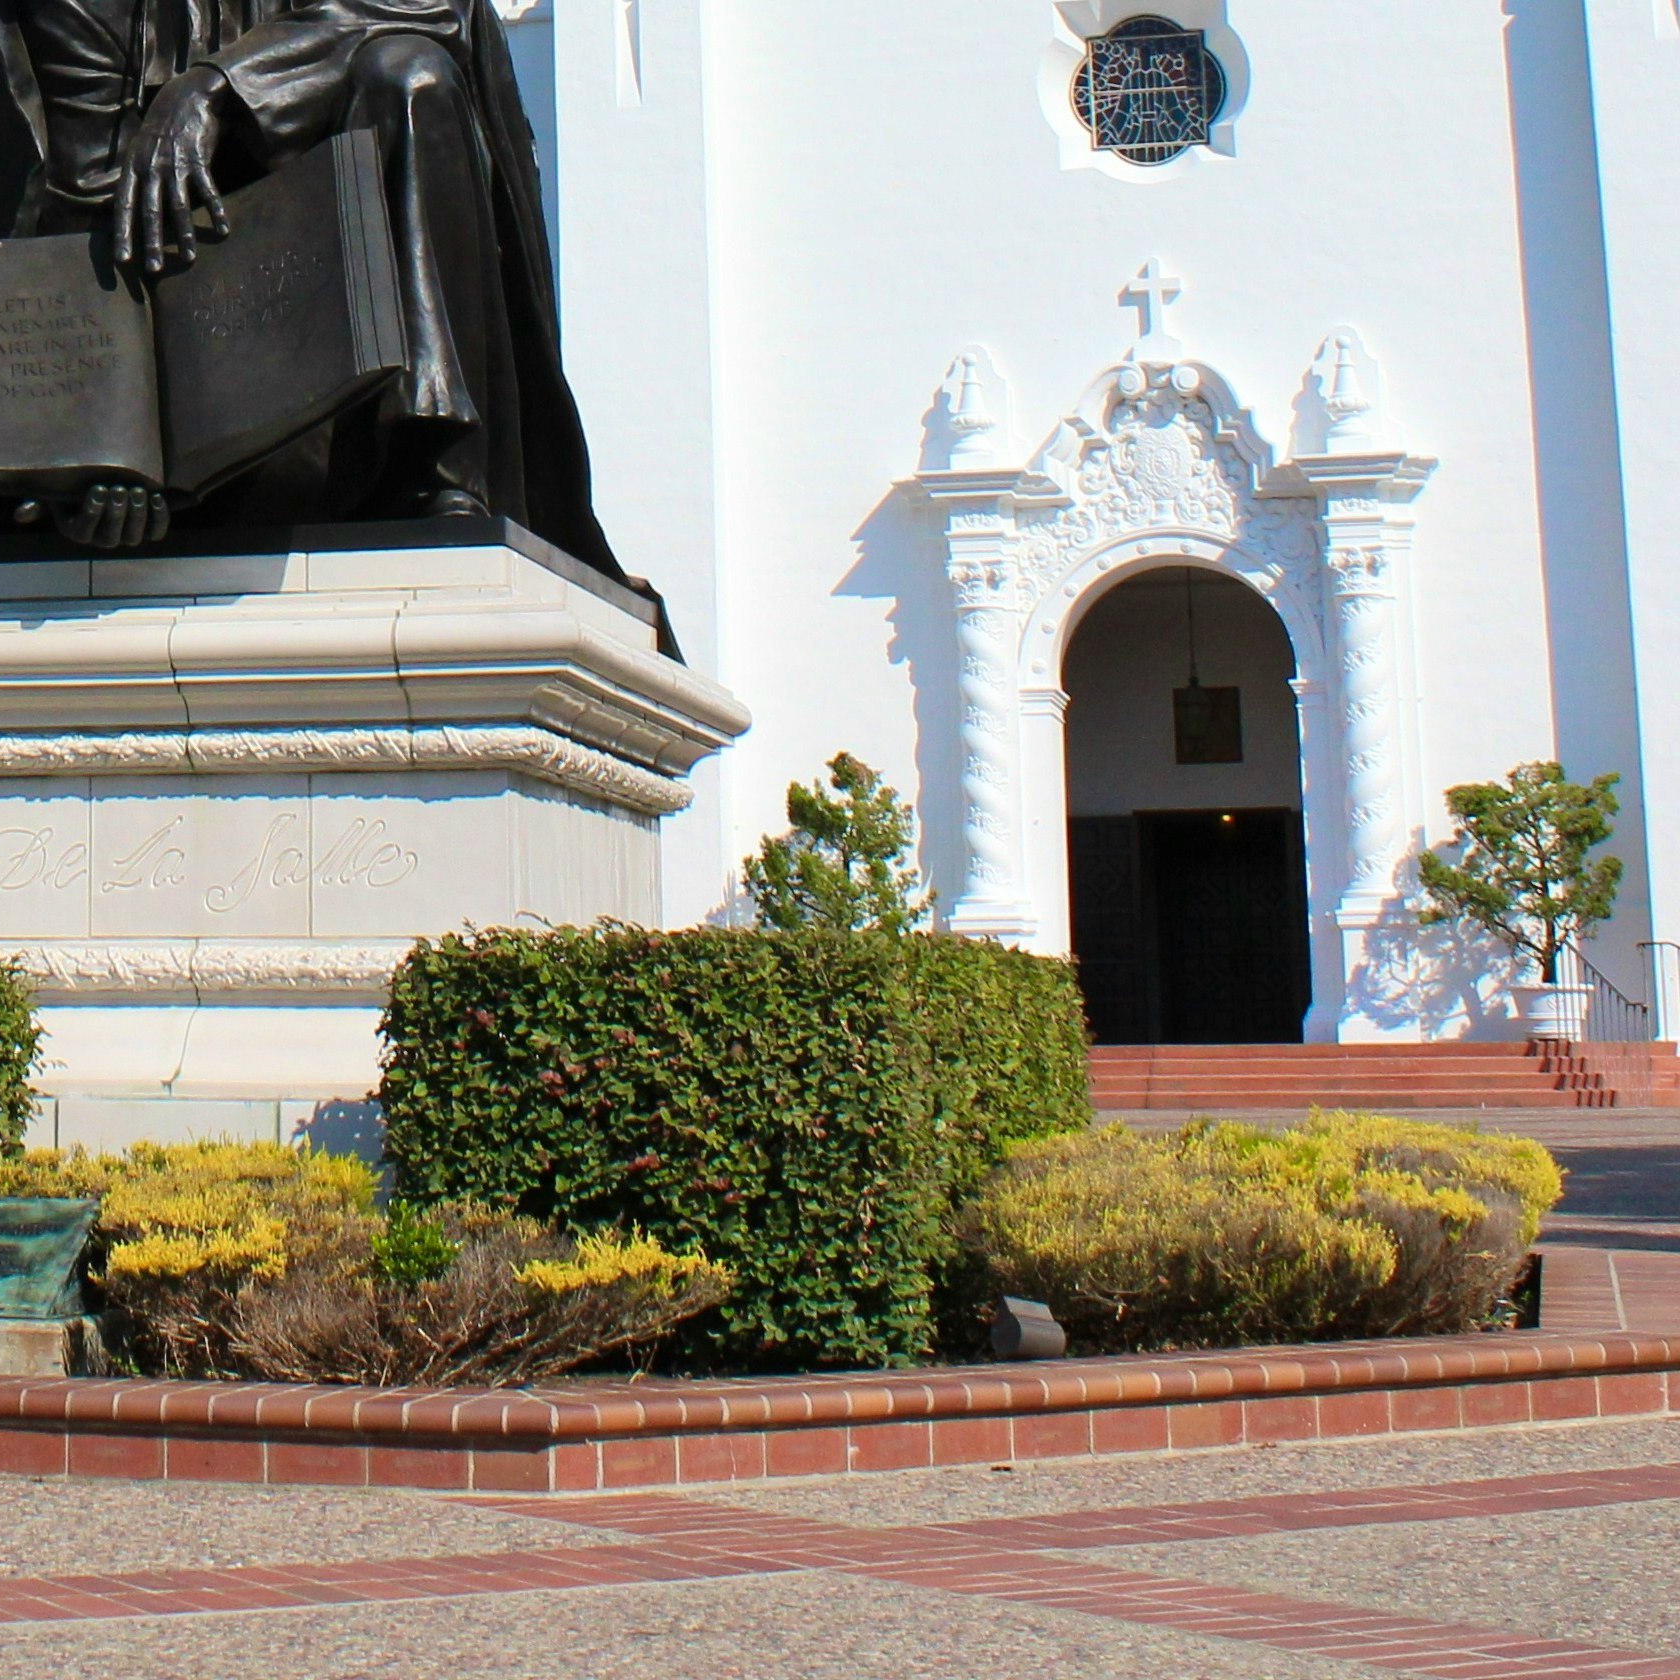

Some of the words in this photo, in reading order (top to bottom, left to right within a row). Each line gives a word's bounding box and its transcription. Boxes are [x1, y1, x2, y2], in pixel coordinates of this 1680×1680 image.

[75, 333, 116, 350] THE
[100, 813, 187, 894] La
[204, 812, 419, 914] Salle
